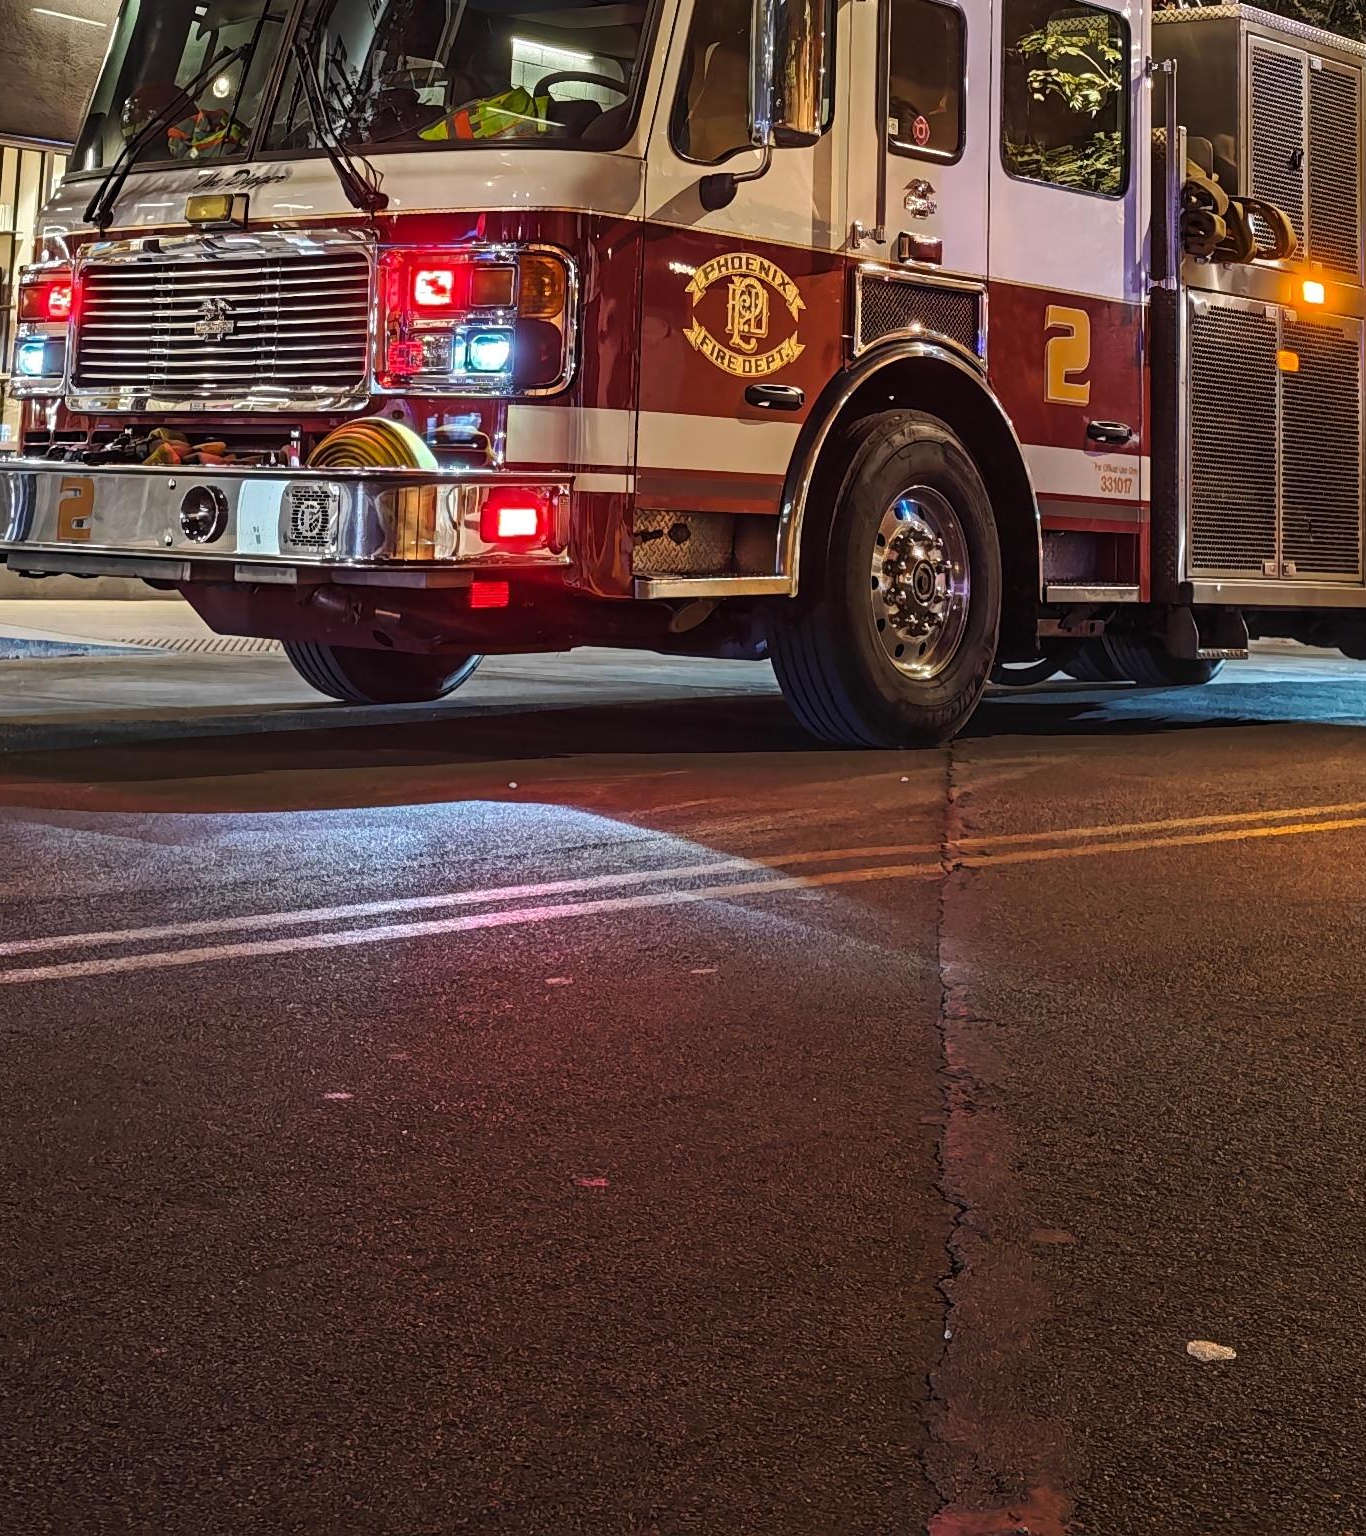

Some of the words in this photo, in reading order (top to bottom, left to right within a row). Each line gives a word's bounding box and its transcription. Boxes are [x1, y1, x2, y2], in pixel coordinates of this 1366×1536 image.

[701, 256, 790, 294] PHOENIX
[700, 335, 738, 371] FIRE
[1044, 304, 1091, 407] 2
[1100, 475, 1133, 494] 331017
[57, 476, 94, 540] 2
